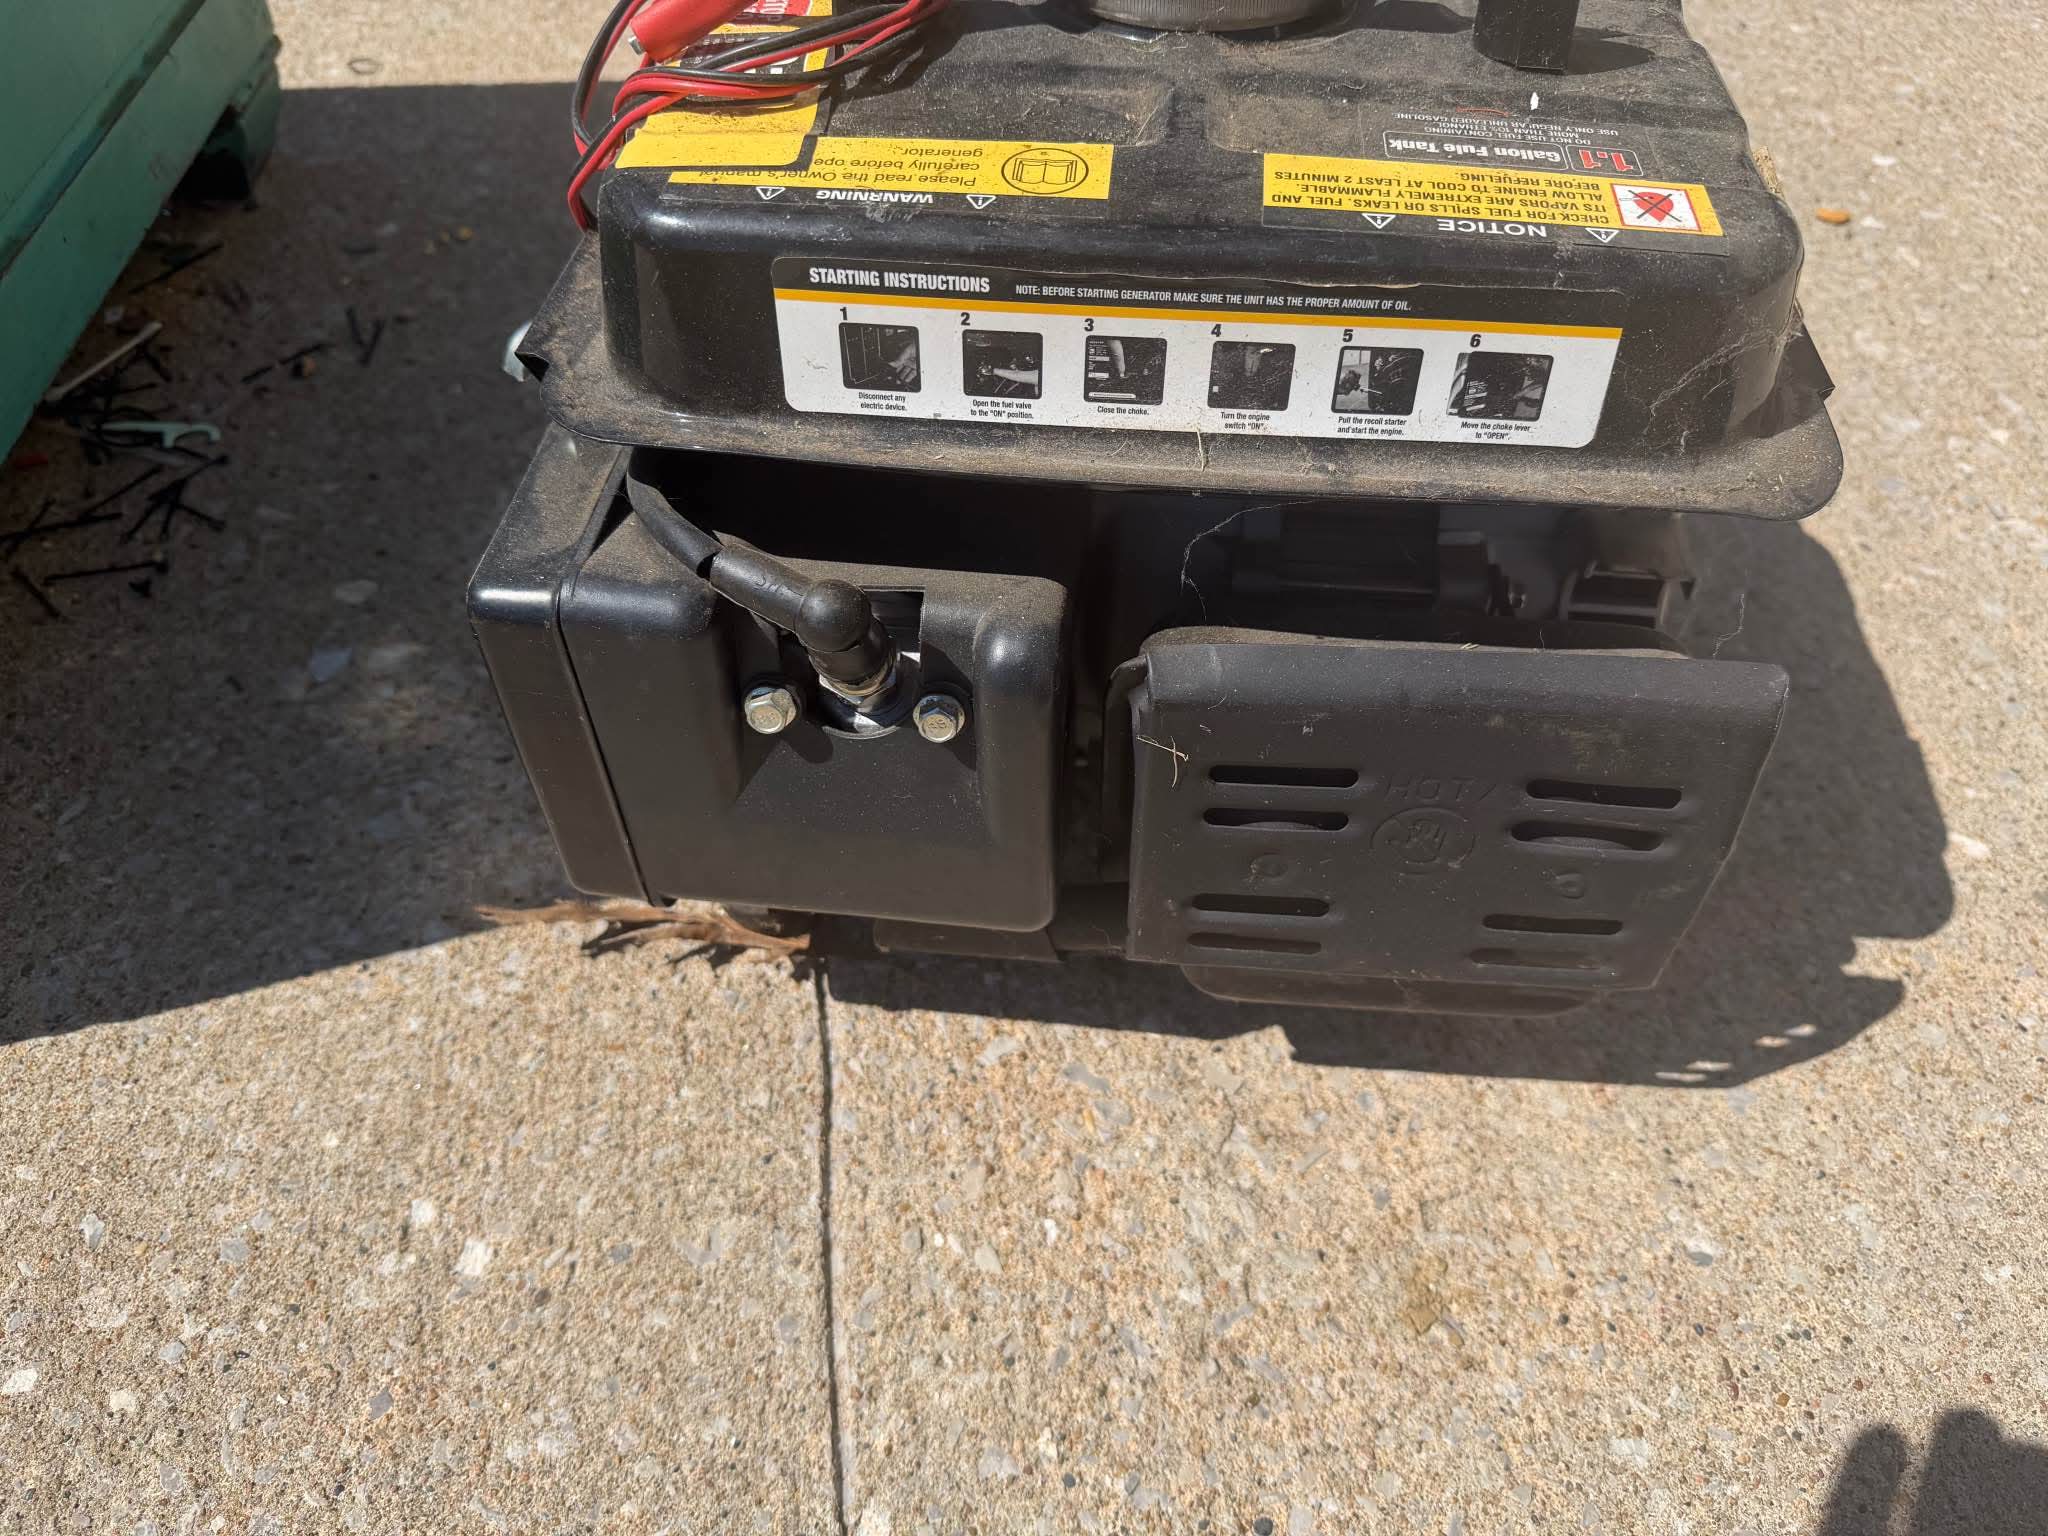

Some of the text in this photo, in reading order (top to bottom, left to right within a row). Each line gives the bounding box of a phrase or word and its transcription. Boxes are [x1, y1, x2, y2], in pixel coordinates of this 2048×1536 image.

[1451, 116, 1508, 127] UNLEADED
[1424, 126, 1492, 137] CONTAINING
[1549, 130, 1579, 138] MORE
[1565, 125, 1594, 134] ONLY
[1597, 128, 1619, 136] USE
[1388, 139, 1561, 162] Gallon Fule Tank
[850, 158, 904, 170] before
[908, 158, 980, 171] carefully
[1578, 149, 1634, 172] 1.1
[768, 170, 837, 182] Owner's
[842, 171, 868, 183] the
[873, 171, 912, 183] read
[918, 173, 976, 187] Please
[1455, 172, 1600, 191] BEFORE REFUELING.
[1274, 171, 1602, 201] ALLOW ENGINE TO COOL AT LEAST 2 MINUTES
[816, 189, 934, 204] WANRNING
[1297, 183, 1606, 213] ITS VAPORS ARE EXTREMELY FLAMMABLE.
[1271, 193, 1609, 224] CHECK FOR FUEL SPILLS OR LEAKS. FUEL AND
[1436, 218, 1548, 238] NOTICE
[809, 267, 991, 293] STARTING INSTRUCTIONS
[1015, 285, 1411, 311] NOTE: BEFORE STARTING GENERATOR MAKE SURE THE UNIT HAS THE PROPER AMOUNT OF OIL.
[840, 306, 848, 321] 1
[960, 312, 970, 326] 2
[1084, 318, 1094, 332] 3
[1211, 323, 1222, 337] 4
[1343, 328, 1353, 342] 5
[1470, 333, 1482, 348] 6
[858, 391, 906, 403] Disconnect any
[860, 402, 907, 411] electric device.
[972, 399, 989, 409] Open
[990, 400, 1000, 408] the
[978, 409, 989, 417] the
[990, 409, 1006, 417] "ON"
[1007, 411, 1034, 420] position.
[1097, 405, 1149, 416] Close the choke.
[1220, 411, 1270, 422] Turn the engine
[1338, 416, 1407, 426] Pull the recoil starter
[1460, 421, 1530, 432] Move the choke lever
[1337, 426, 1404, 436] and start the engine.
[1483, 432, 1510, 440] "OPEN".
